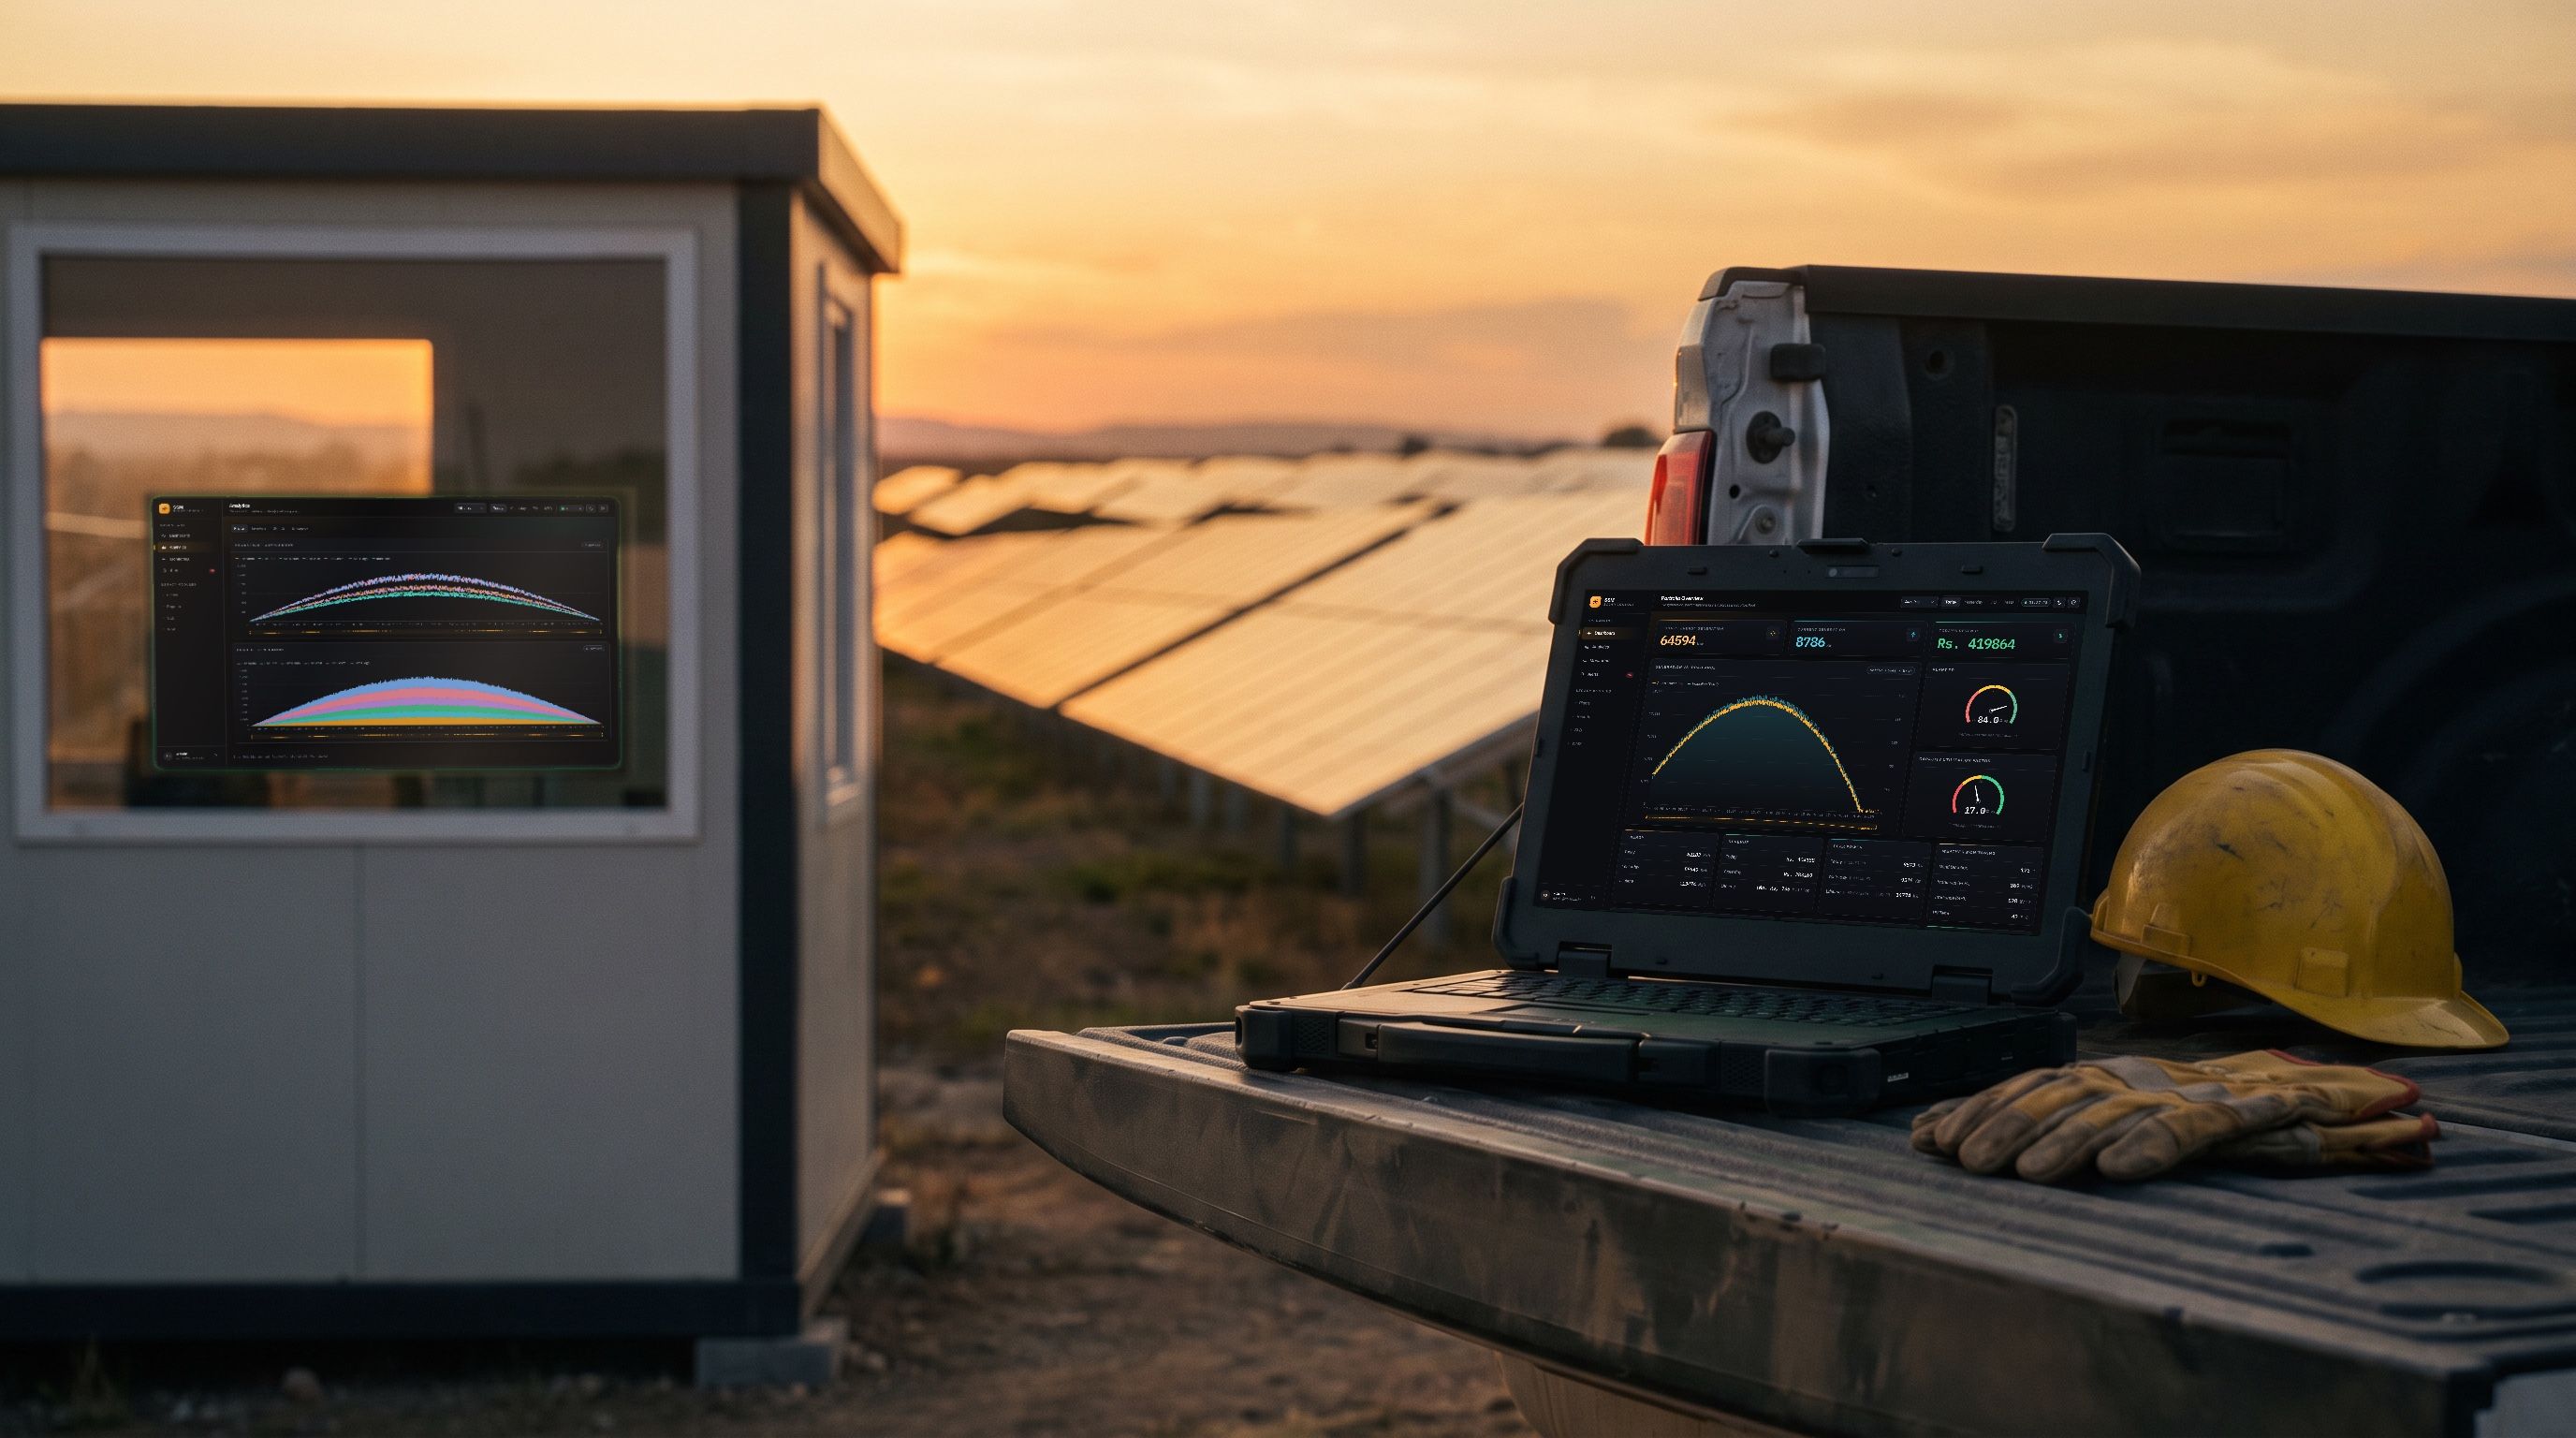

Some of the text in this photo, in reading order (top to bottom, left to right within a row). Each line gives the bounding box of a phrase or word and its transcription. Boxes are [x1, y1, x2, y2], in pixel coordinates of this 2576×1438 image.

[1660, 635, 1696, 646] 64594
[1795, 637, 1826, 648] 8786
[1937, 638, 2016, 651] Rs. 419864
[1977, 715, 1999, 725] 84.0
[1964, 806, 1986, 815] 17.0
